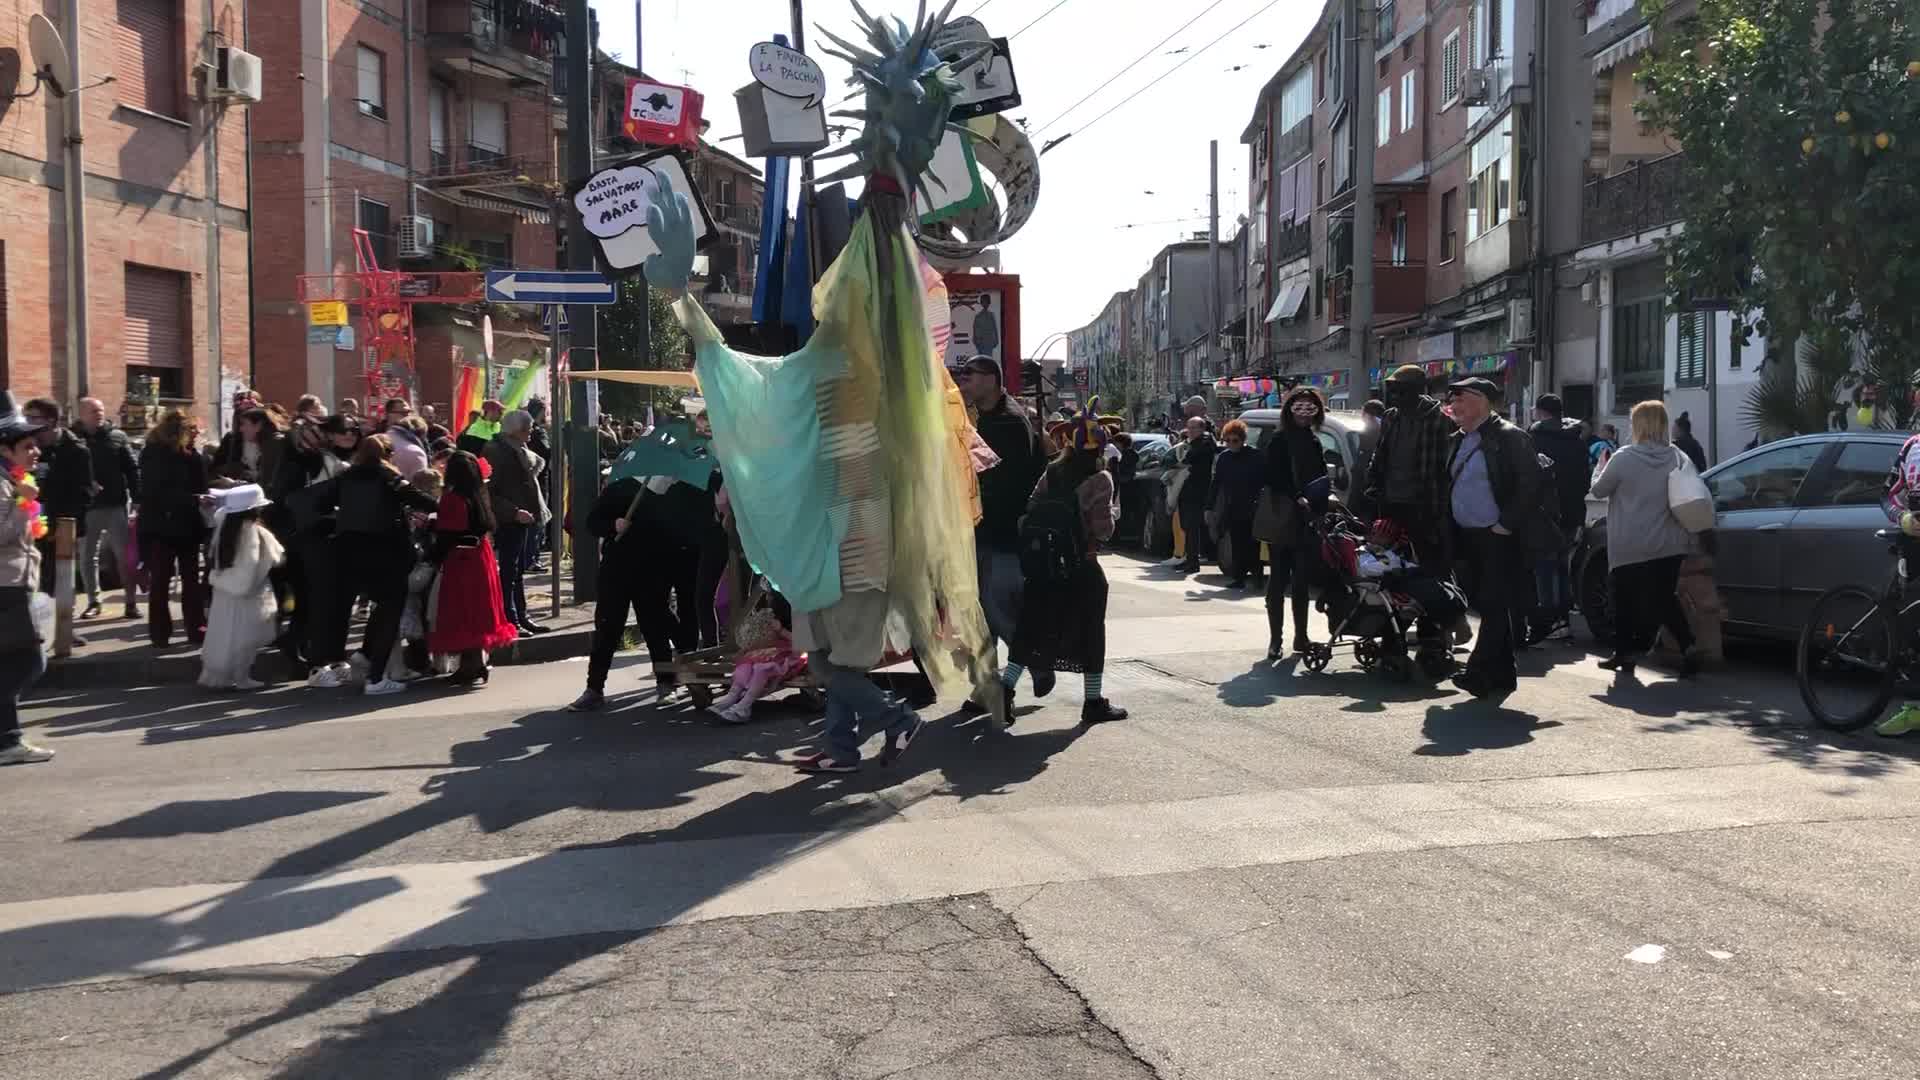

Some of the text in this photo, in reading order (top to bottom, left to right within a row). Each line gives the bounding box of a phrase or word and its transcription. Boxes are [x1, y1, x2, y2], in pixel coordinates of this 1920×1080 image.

[759, 63, 819, 84] LA PACCHIA
[585, 179, 644, 207] SALVATAGGI
[588, 175, 619, 193] BASTA
[599, 199, 639, 225] MARE
